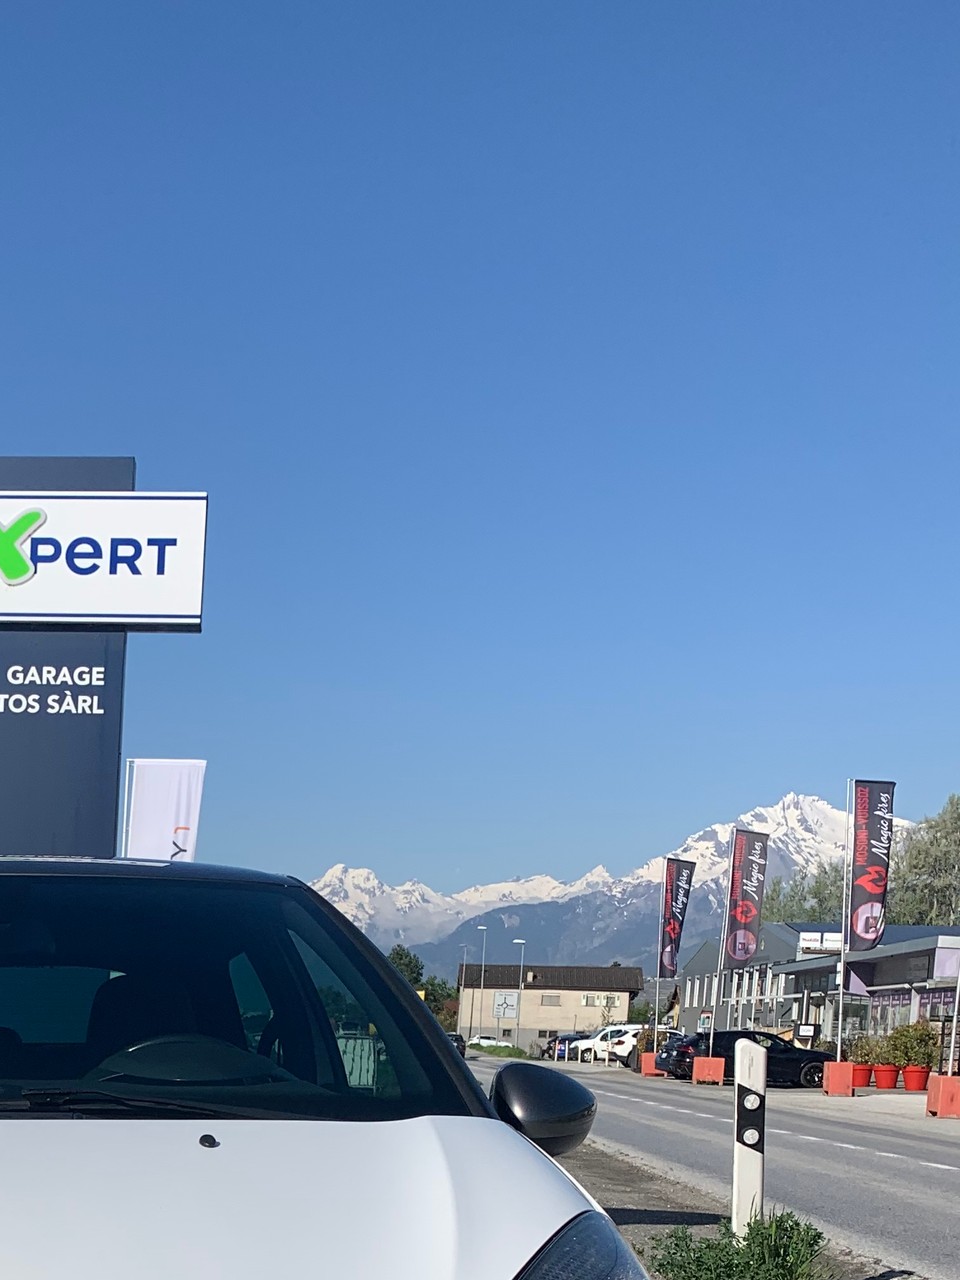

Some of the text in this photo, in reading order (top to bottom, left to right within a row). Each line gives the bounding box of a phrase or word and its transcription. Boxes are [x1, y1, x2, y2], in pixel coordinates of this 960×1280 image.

[6, 666, 105, 686] GARAGE
[46, 691, 104, 714] SÀRL
[870, 792, 893, 863] Magic fires
[743, 841, 766, 901] Magic fires
[672, 887, 688, 921] Magic
